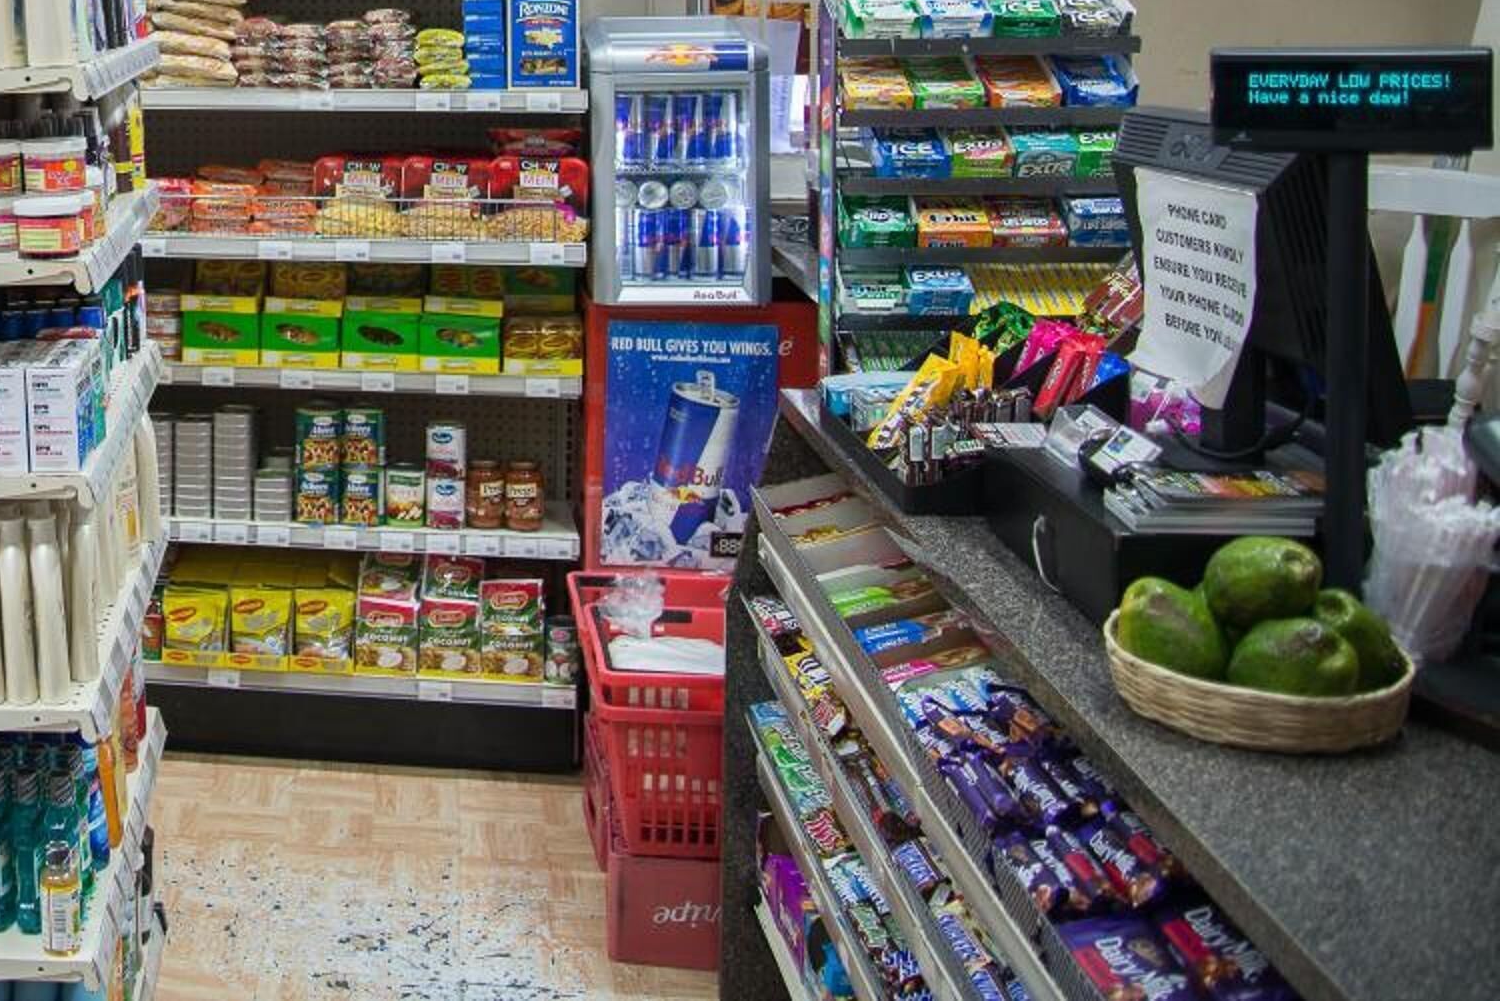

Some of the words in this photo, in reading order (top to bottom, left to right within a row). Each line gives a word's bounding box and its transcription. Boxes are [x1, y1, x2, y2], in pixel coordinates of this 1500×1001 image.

[518, 2, 569, 17] RONZONI
[1249, 73, 1330, 89] EVERYDAY
[1339, 74, 1371, 88] LOW
[1379, 74, 1450, 88] PRICES!
[1249, 91, 1290, 104] Have
[1298, 94, 1310, 104] a
[1318, 91, 1360, 104] nice
[1369, 91, 1410, 106] day!
[892, 141, 933, 154] ICE
[347, 161, 381, 173] CHW
[433, 161, 468, 173] CHW
[521, 159, 557, 173] CHW
[1167, 203, 1202, 225] PHONE
[1202, 210, 1228, 230] CARD
[1155, 228, 1212, 257] CUSTOMERS
[1213, 242, 1245, 265] KINDLY
[1153, 256, 1191, 277] ENSURE
[1191, 265, 1213, 285] YOU
[1159, 283, 1187, 305] YOUR
[1187, 292, 1221, 316] PHONE
[1164, 312, 1202, 337] BEFORE
[611, 336, 634, 350] RED
[636, 337, 662, 352] BULL
[665, 339, 699, 353] GIVES
[702, 340, 727, 354] YOU
[729, 341, 773, 357] WINGS.
[1095, 935, 1139, 977] Dairy
